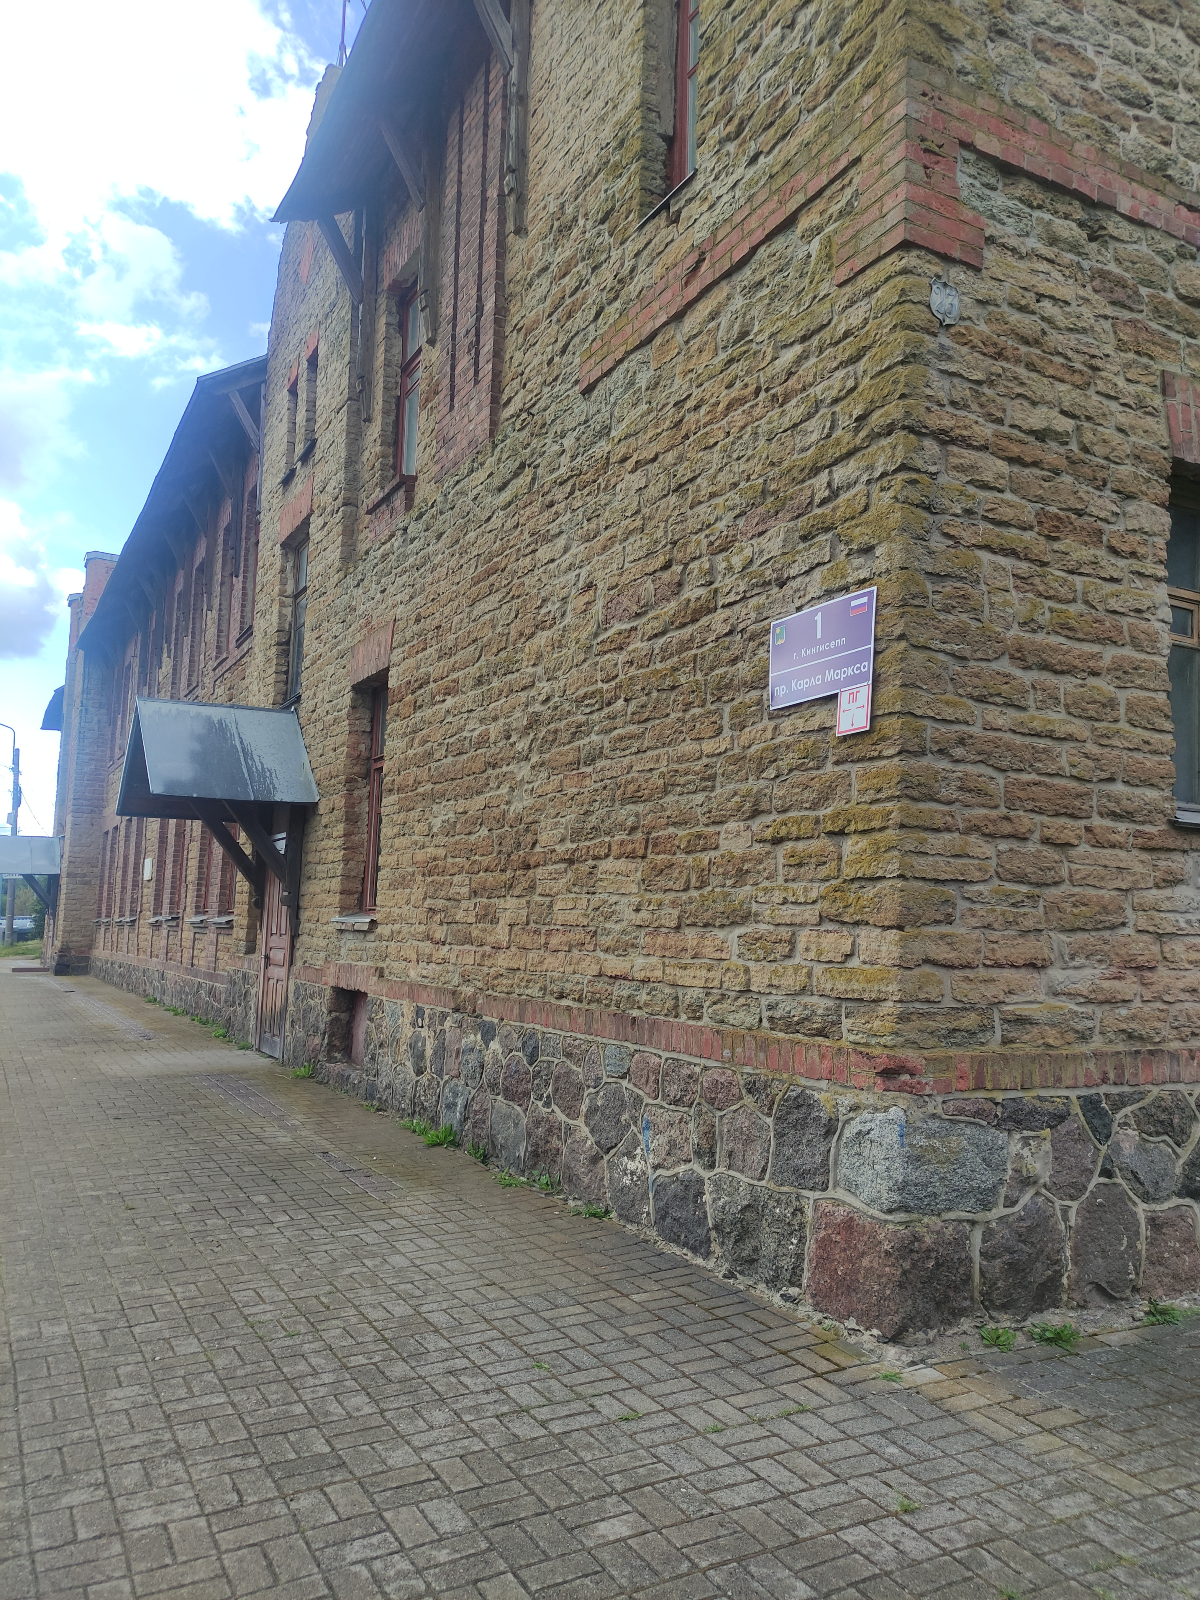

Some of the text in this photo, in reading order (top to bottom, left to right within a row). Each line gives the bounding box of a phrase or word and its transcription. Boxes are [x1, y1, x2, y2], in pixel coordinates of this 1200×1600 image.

[814, 611, 822, 640] 1
[793, 637, 846, 660] г. Кингисепп
[774, 661, 868, 697] пр. Карла Маркса
[848, 690, 860, 705] ПГ
